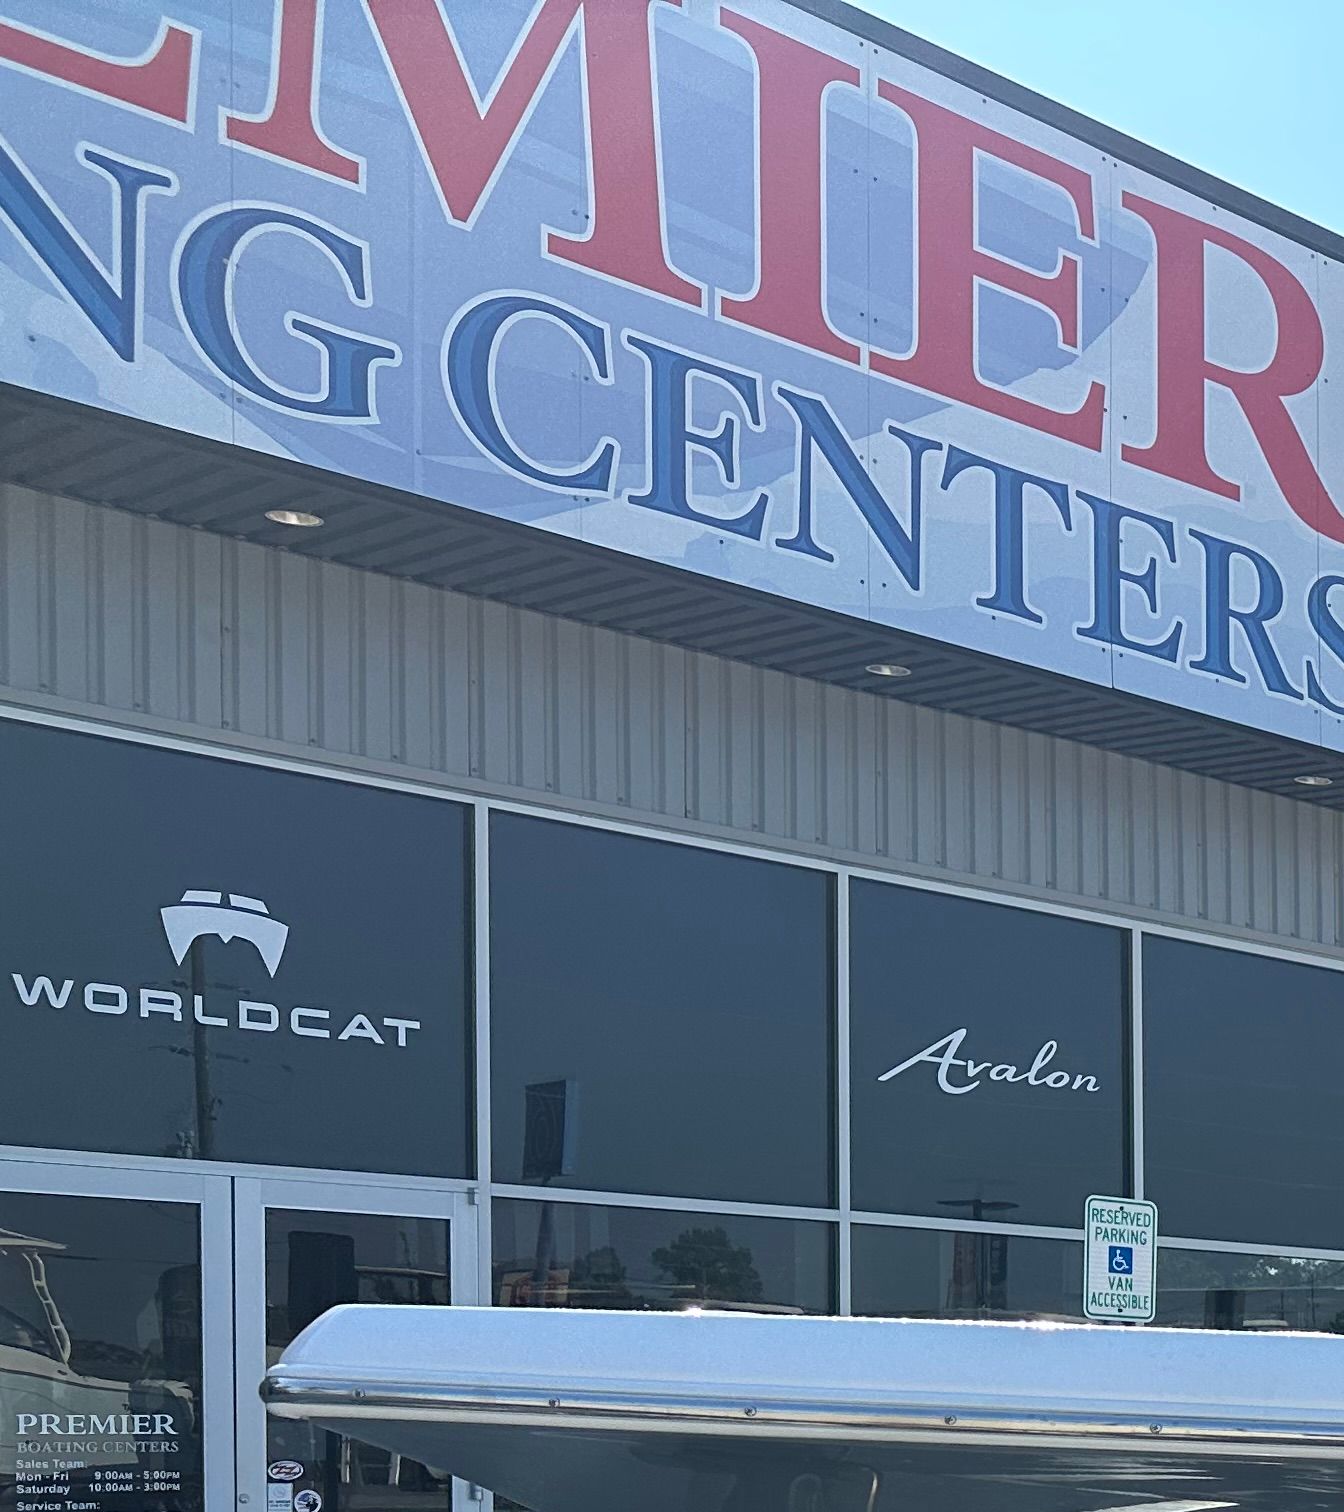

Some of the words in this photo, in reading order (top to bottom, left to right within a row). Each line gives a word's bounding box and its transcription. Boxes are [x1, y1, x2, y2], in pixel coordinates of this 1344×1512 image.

[12, 973, 421, 1047] WORLDCAT
[877, 1028, 1100, 1095] Avalon
[1091, 1207, 1152, 1228] RESERVED
[1095, 1226, 1148, 1245] PARKING
[1108, 1275, 1133, 1292] VAN
[1090, 1291, 1150, 1310] ACCESSIBLE
[15, 1413, 180, 1435] PREMIER
[17, 1441, 98, 1453] BOATING
[102, 1440, 179, 1453] CENTERS
[16, 1459, 49, 1469] Sales
[52, 1458, 88, 1469] Team:
[16, 1471, 42, 1481] Mon
[53, 1471, 69, 1481] Fri
[94, 1470, 133, 1480] 9:00AM
[143, 1470, 180, 1480] 5:00PM
[16, 1483, 71, 1495] Saturday
[88, 1482, 133, 1492] 10:00AM
[16, 1501, 62, 1511] Service
[65, 1500, 101, 1511] Team:
